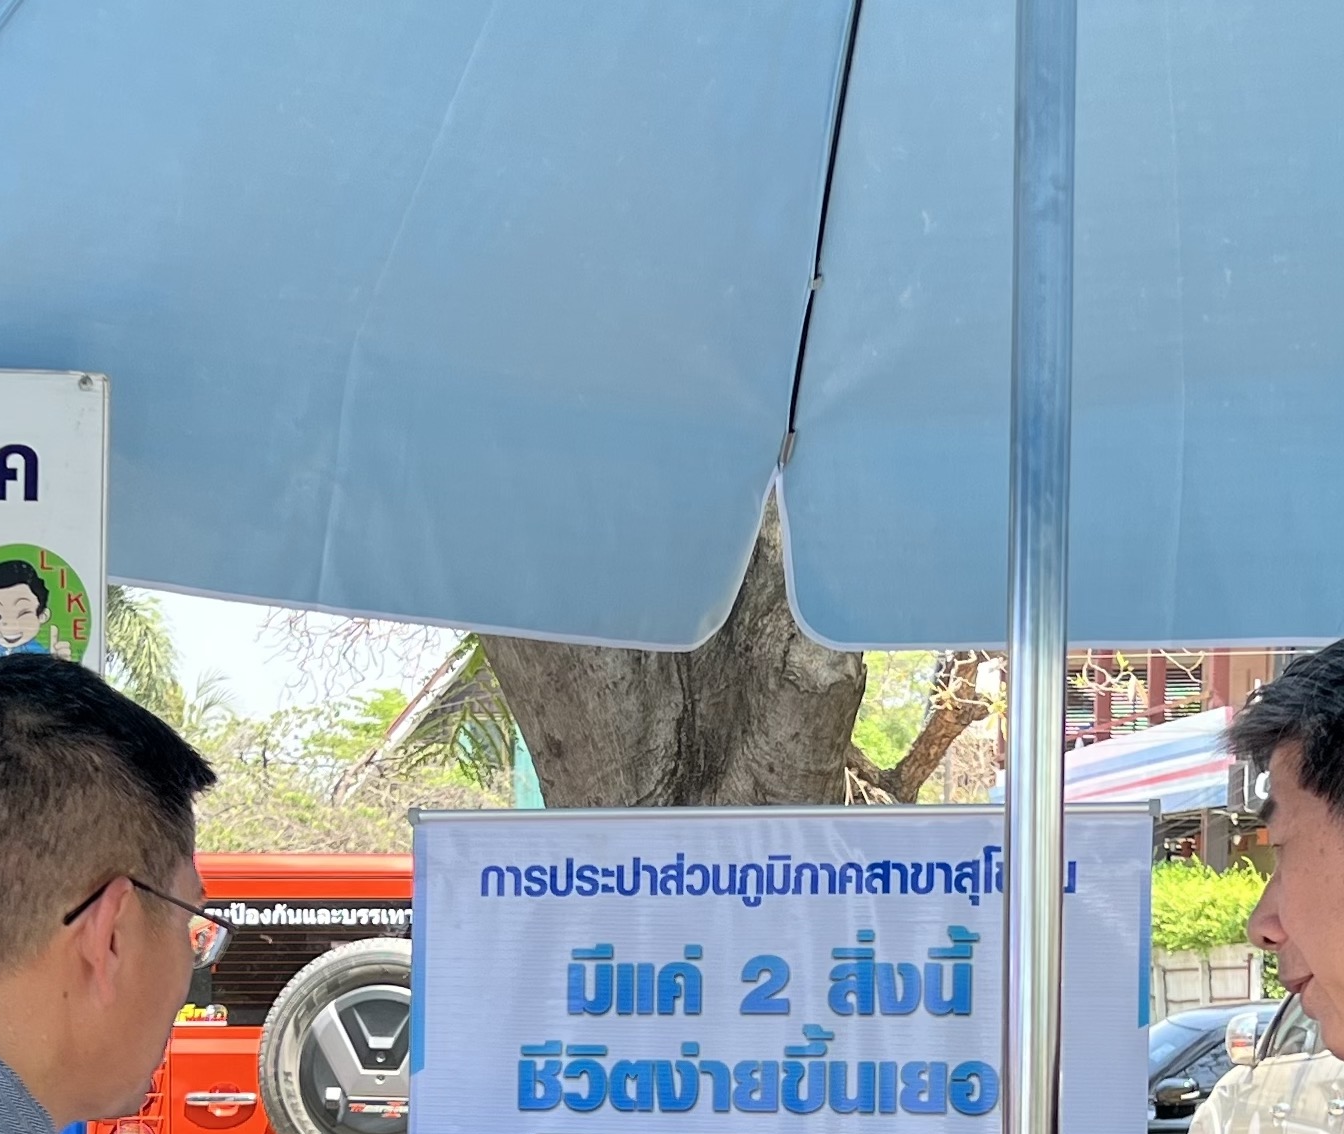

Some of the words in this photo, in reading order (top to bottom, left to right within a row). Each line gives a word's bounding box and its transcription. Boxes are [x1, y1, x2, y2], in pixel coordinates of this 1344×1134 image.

[40, 550, 87, 640] LIKE
[481, 846, 1076, 907] การประปาส่วนภูมิภาคสาขาสุโ
[567, 942, 703, 1016] มีแค่
[739, 955, 791, 1016] 2
[827, 925, 980, 1017] สิ่งนี้
[517, 1024, 1000, 1115] ชีวิตง่ายขึ้นเยอ
